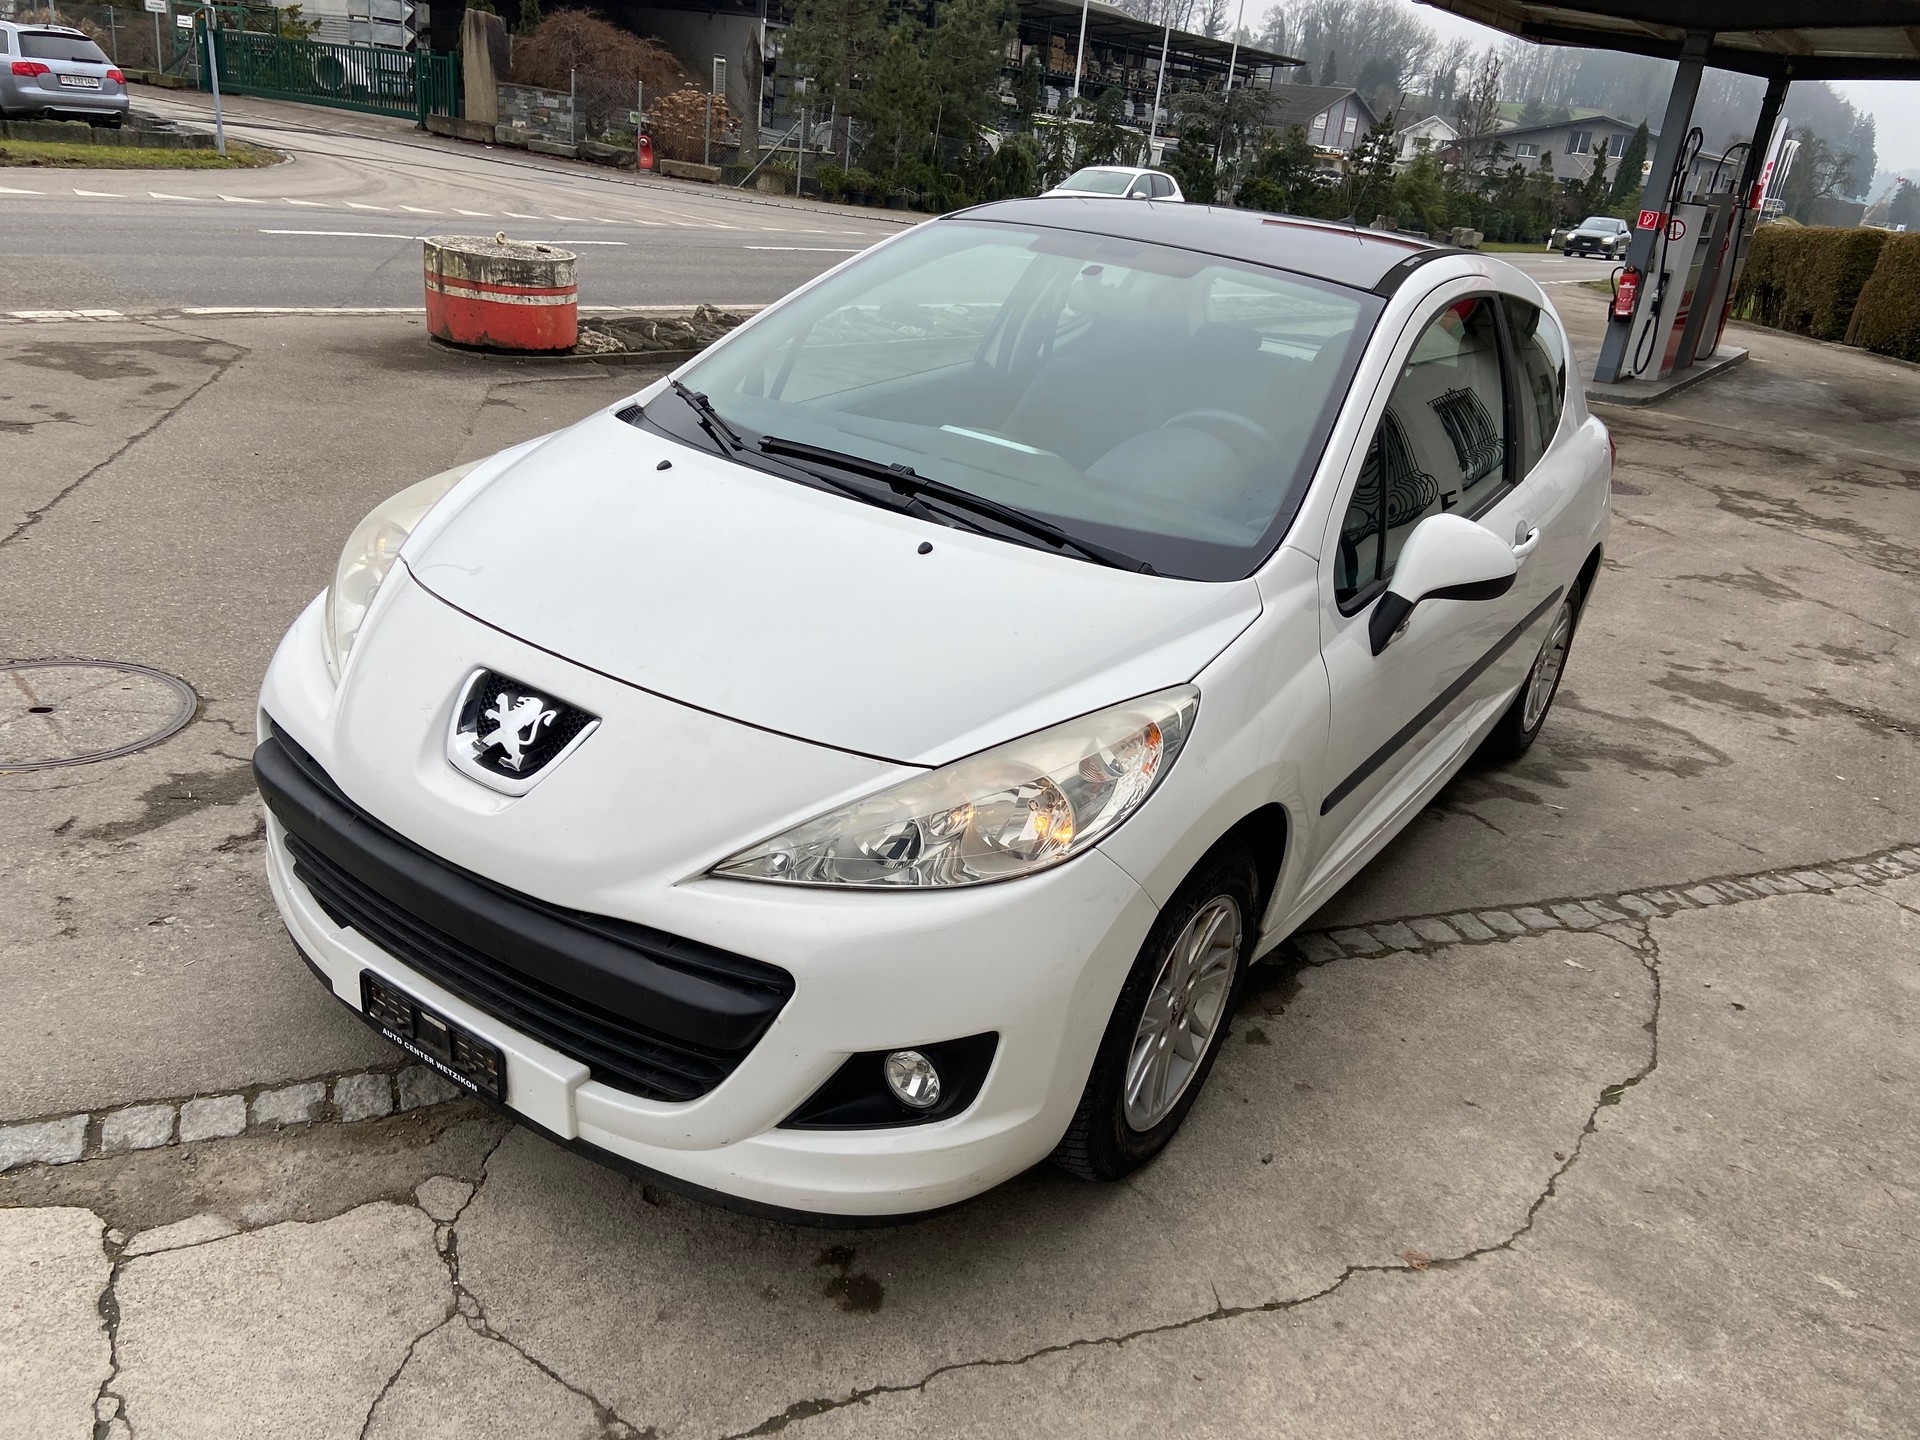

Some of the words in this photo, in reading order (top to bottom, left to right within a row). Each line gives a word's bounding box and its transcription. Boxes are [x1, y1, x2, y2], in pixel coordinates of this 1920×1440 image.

[382, 1027, 402, 1045] AUTO
[404, 1041, 435, 1066] CENTER
[436, 1061, 478, 1092] WETZIKON
